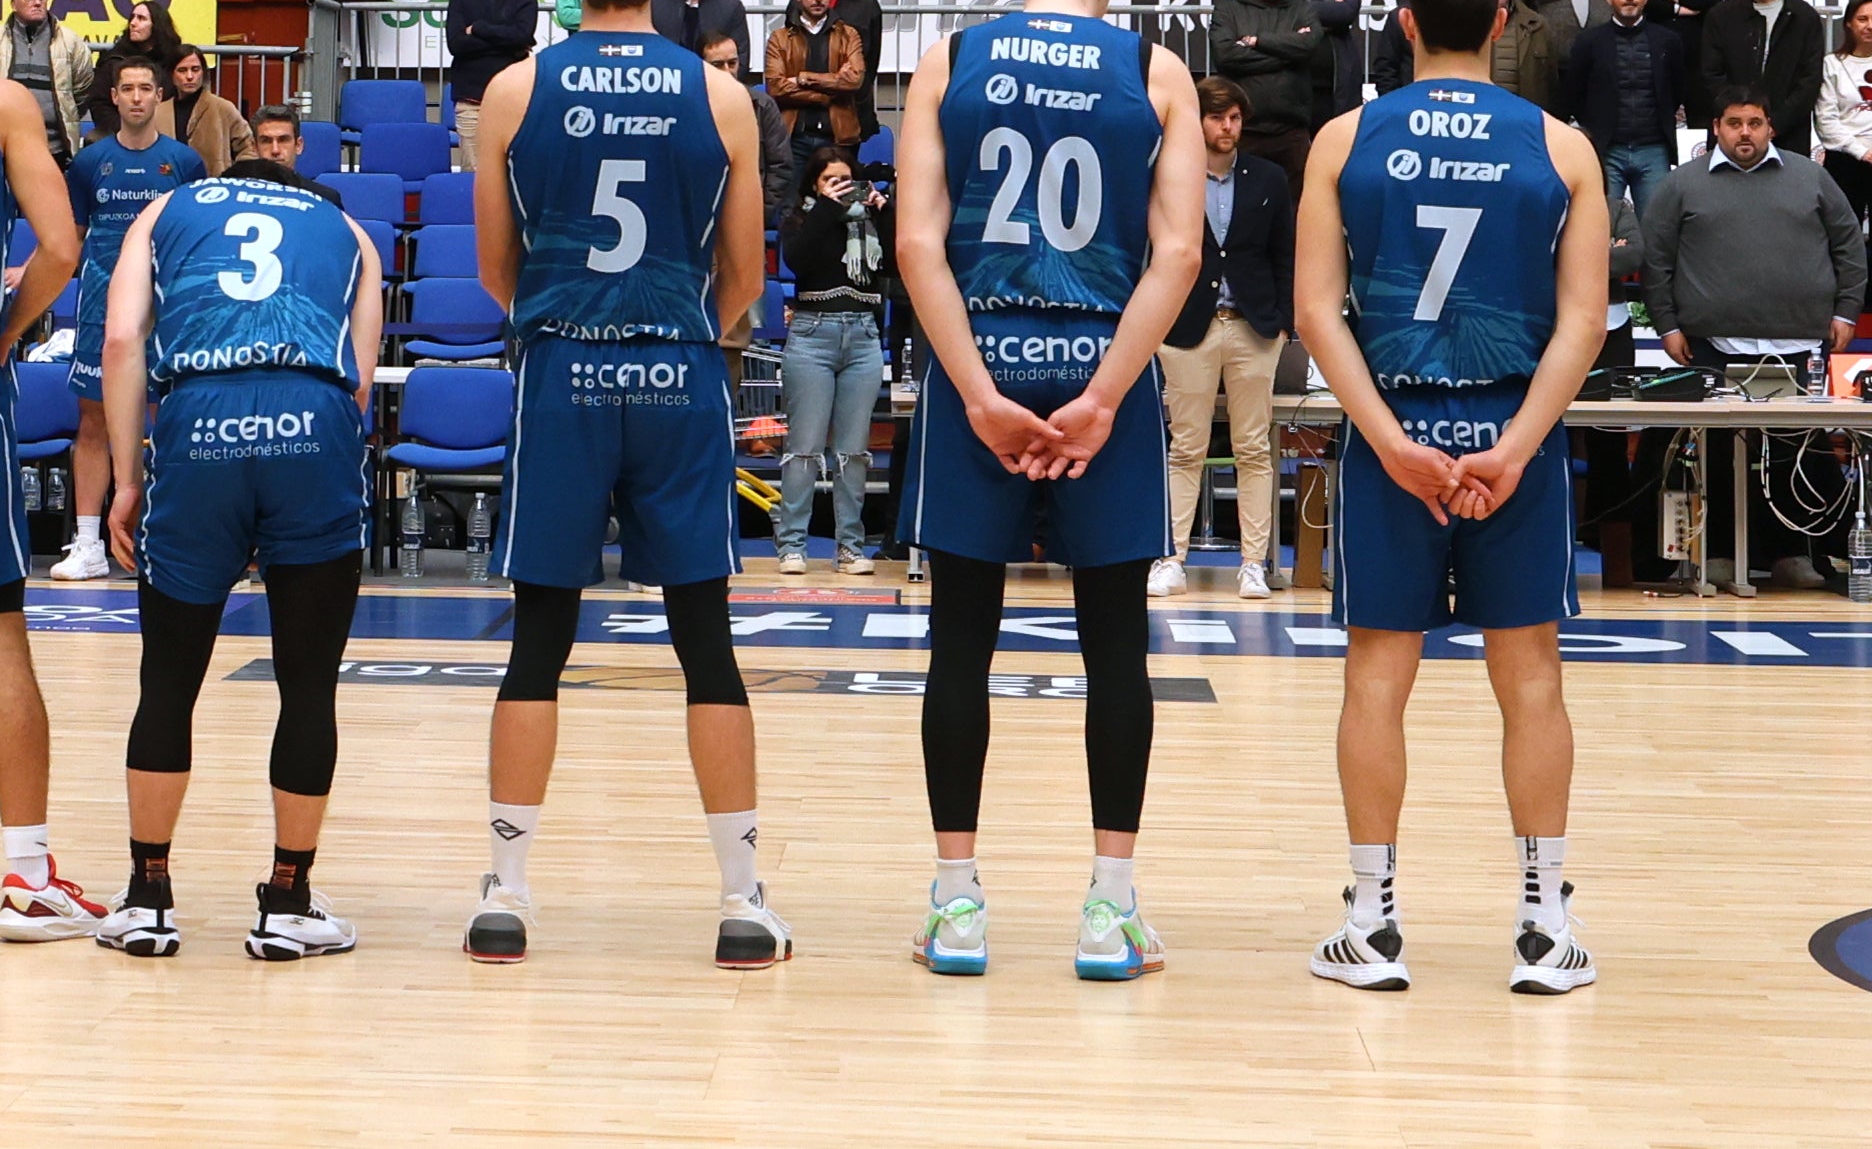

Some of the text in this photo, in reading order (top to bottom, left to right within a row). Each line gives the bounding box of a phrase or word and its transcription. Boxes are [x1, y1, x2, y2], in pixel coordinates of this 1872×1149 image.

[990, 37, 1102, 70] NURGER
[560, 65, 682, 95] CARLSON
[1023, 82, 1102, 112] Irizar
[602, 112, 678, 137] Irizar
[1408, 108, 1492, 140] OROZ
[1429, 156, 1511, 182] Irizar
[236, 190, 315, 213] Irizar
[978, 126, 1103, 253] 20
[586, 159, 648, 275] 5
[216, 212, 285, 303] 3
[1412, 204, 1484, 322] 7
[173, 341, 308, 374] DONOSTIA
[188, 440, 321, 461] electrodomésticos
